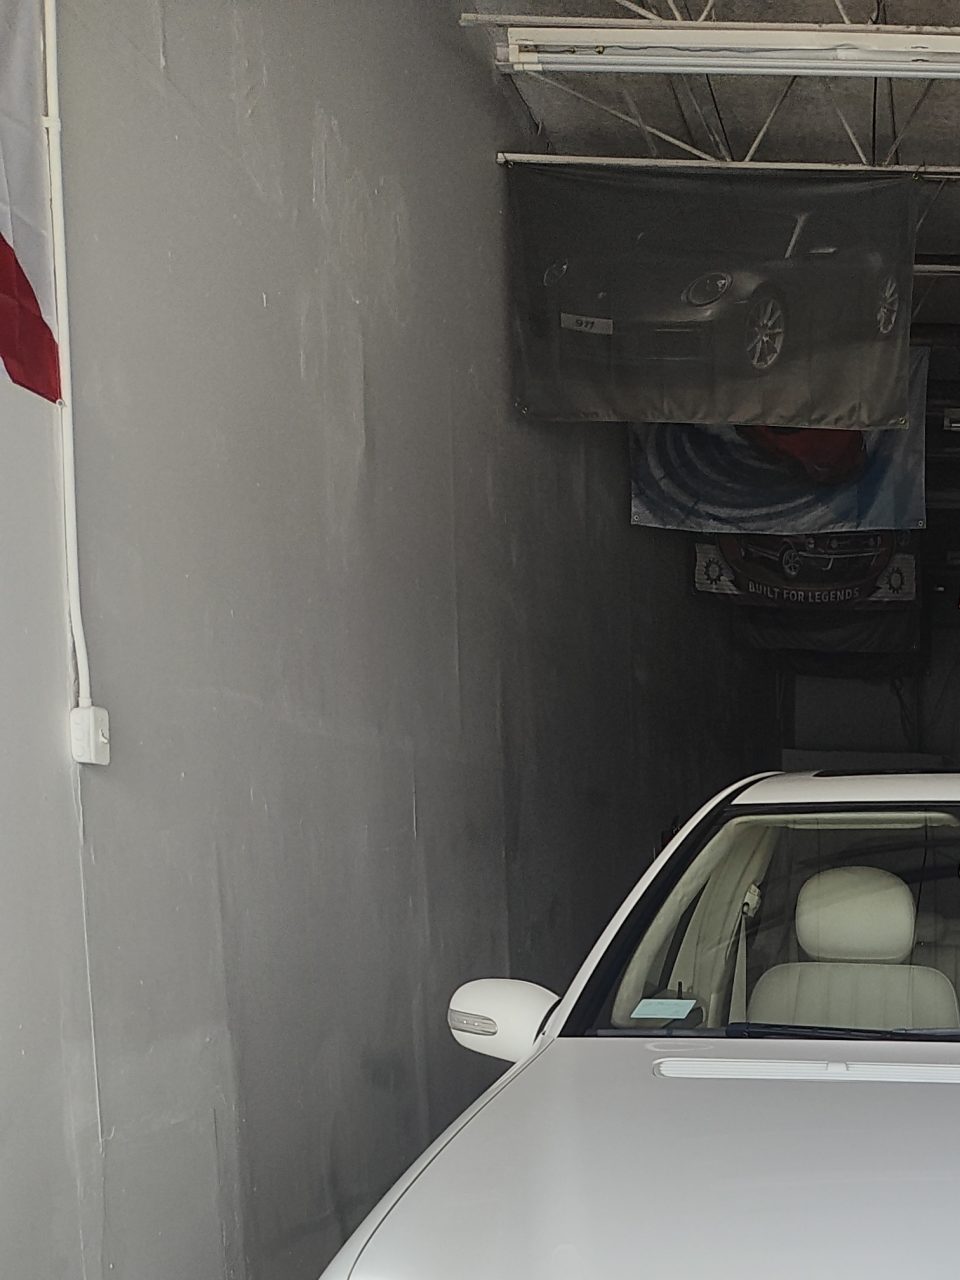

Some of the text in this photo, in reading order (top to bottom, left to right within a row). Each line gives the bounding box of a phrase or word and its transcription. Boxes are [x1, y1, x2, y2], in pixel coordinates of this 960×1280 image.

[576, 319, 595, 329] 911
[748, 580, 860, 603] BUILT FOR LEGENDS
